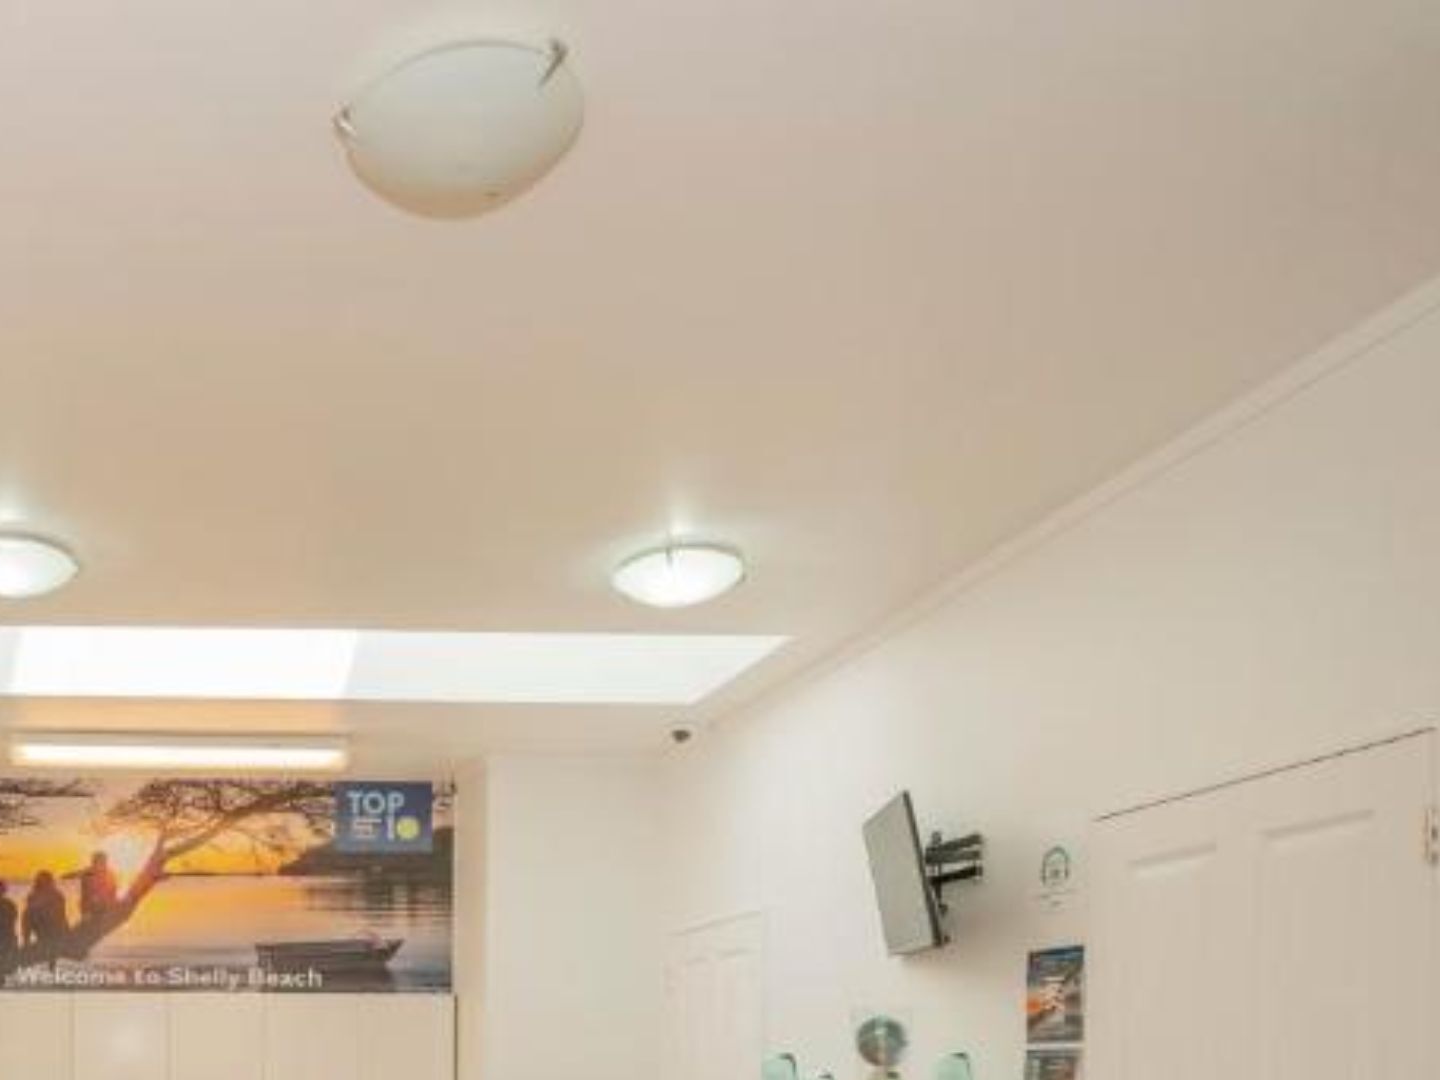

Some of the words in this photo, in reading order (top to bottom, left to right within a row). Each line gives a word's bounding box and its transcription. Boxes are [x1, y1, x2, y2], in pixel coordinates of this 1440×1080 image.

[346, 789, 405, 814] TOP
[16, 966, 127, 986] Welcome
[135, 967, 160, 986] to
[162, 966, 240, 990] Shelly
[248, 967, 323, 987] Beach
